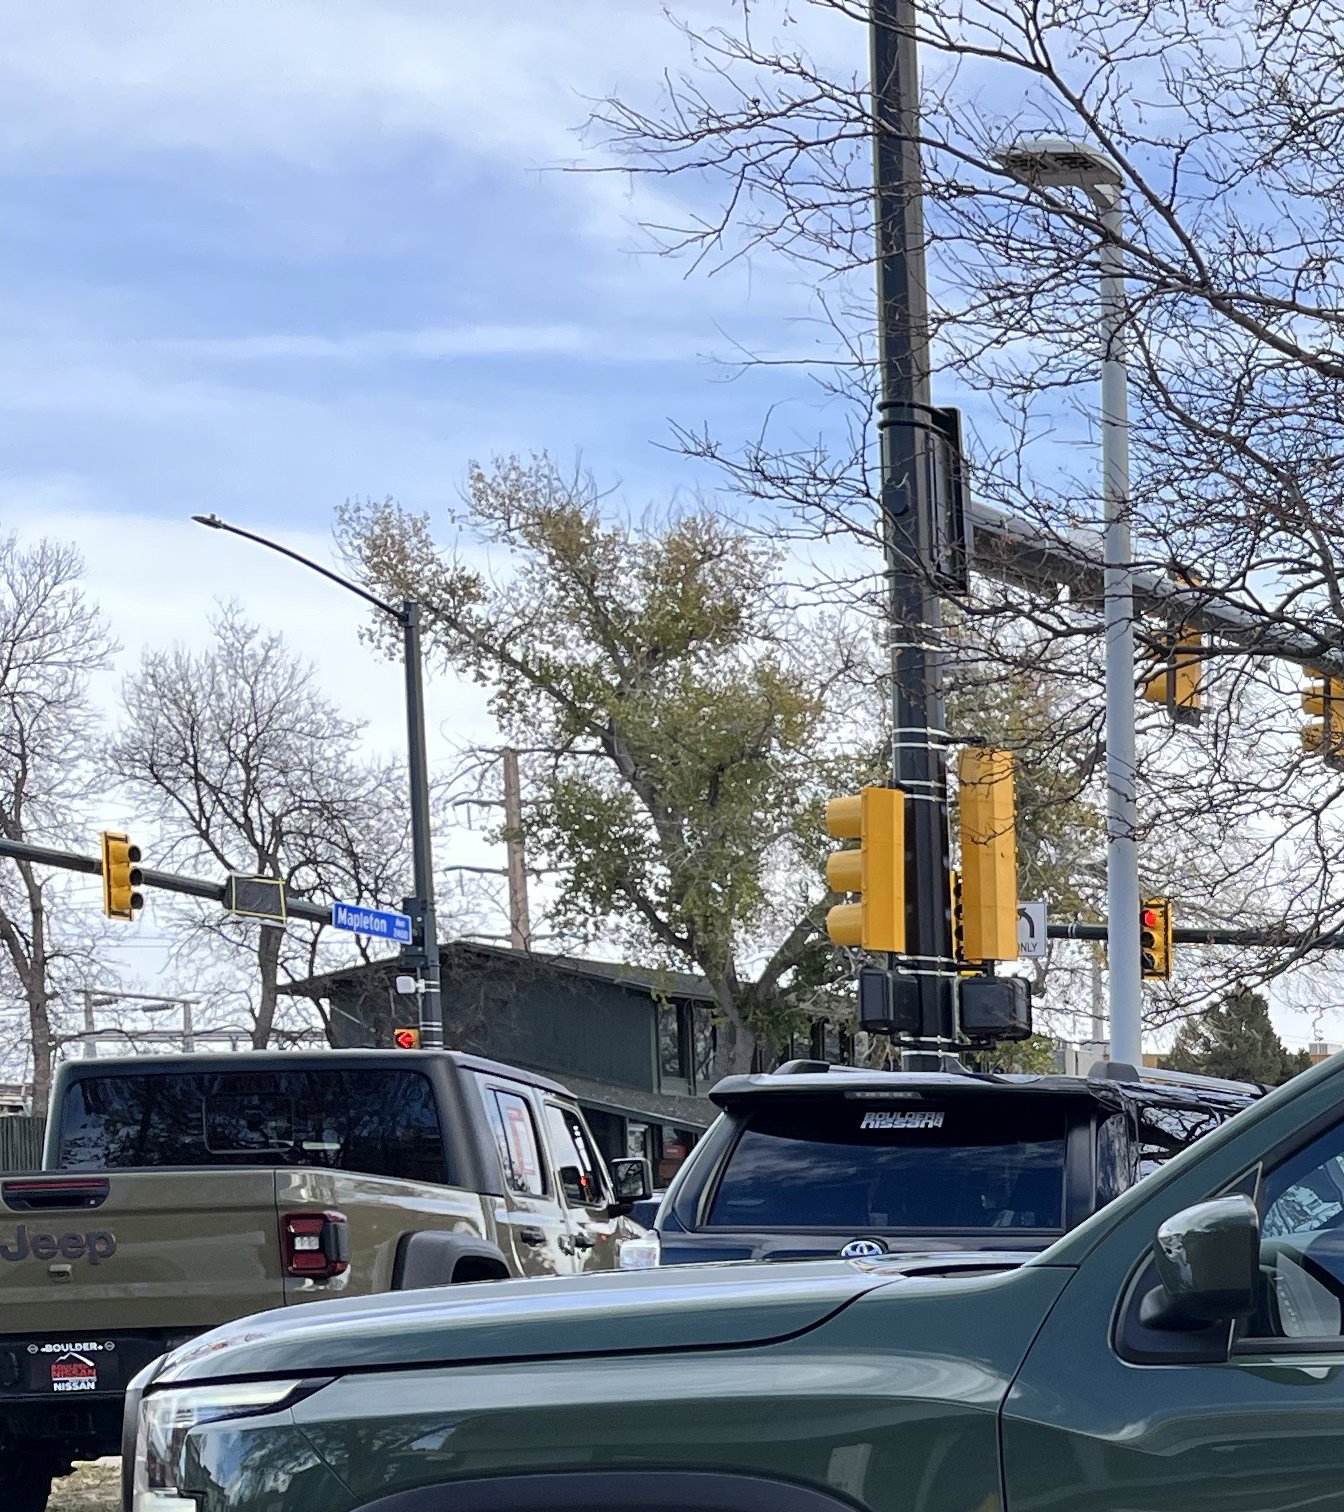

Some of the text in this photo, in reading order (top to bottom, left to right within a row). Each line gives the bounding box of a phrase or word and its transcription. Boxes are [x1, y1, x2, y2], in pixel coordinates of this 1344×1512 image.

[338, 906, 387, 933] Mapleton
[1018, 942, 1038, 953] NLY
[864, 1112, 936, 1121] BOULDER
[0, 1224, 117, 1266] Jeep
[44, 1342, 98, 1353] BOULDER
[53, 1381, 96, 1391] NISSAN
